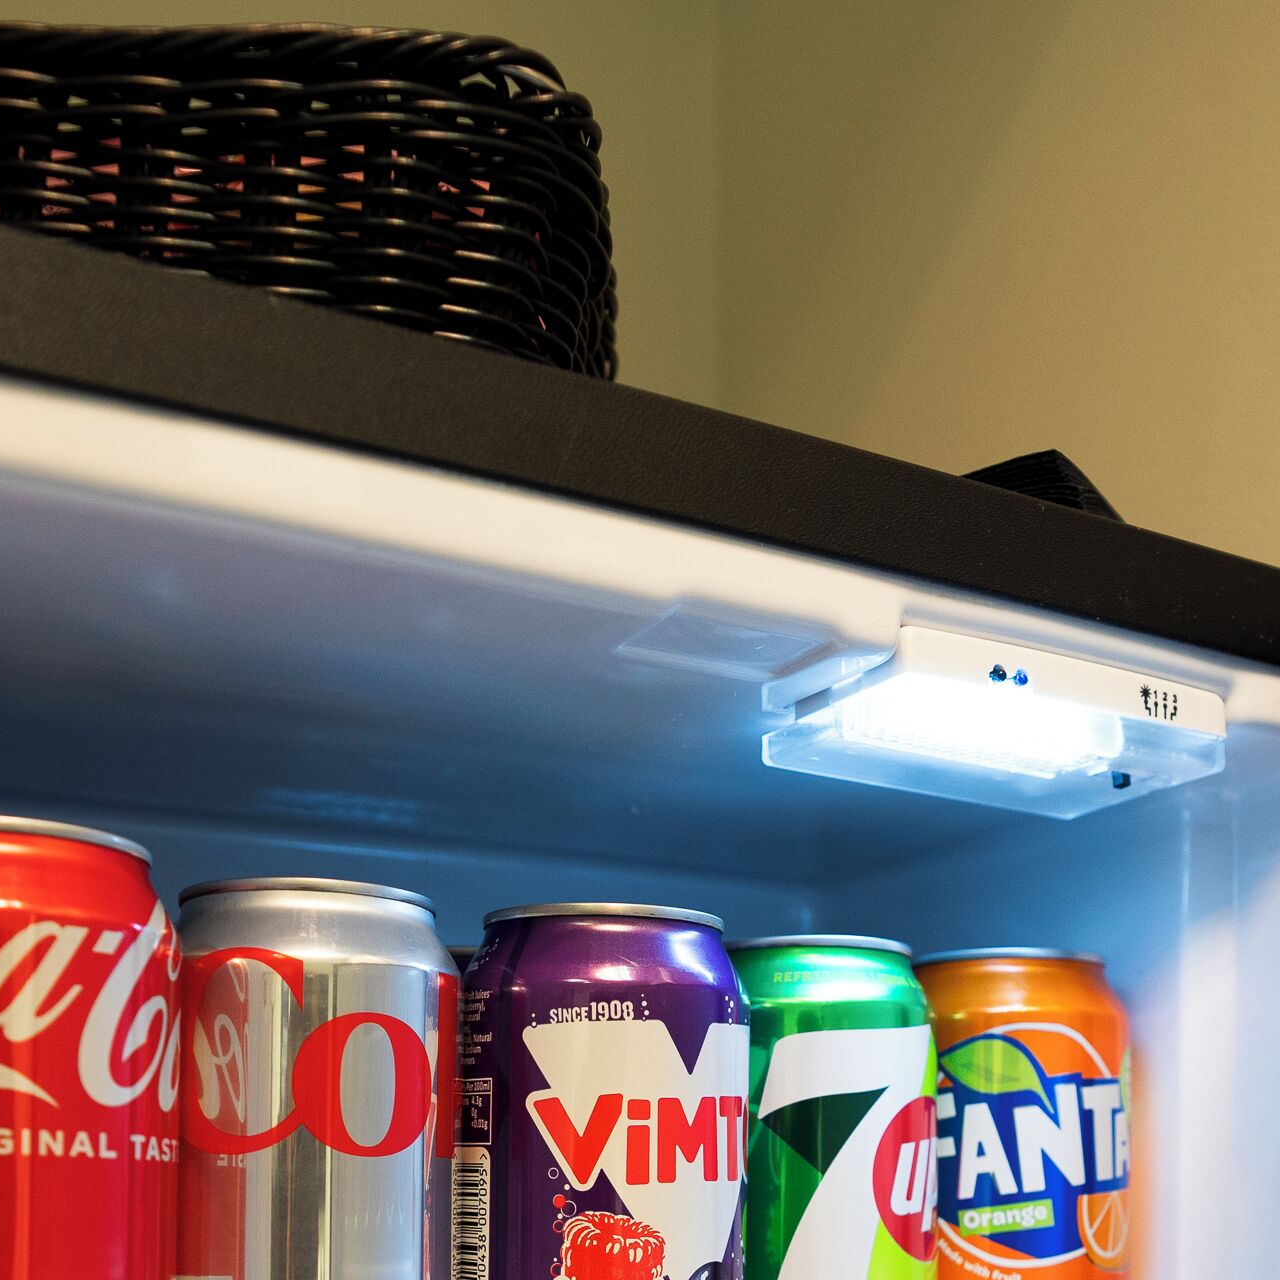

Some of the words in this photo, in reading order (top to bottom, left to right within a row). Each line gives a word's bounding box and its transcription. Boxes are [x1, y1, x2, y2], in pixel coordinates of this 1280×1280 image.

[1153, 690, 1158, 699] 1
[1163, 692, 1168, 701] 2
[1172, 694, 1178, 703] 3
[549, 1007, 589, 1024] SINCE
[590, 1000, 635, 1021] 1908
[533, 1093, 748, 1185] ViMT
[962, 1205, 1048, 1230] Orange
